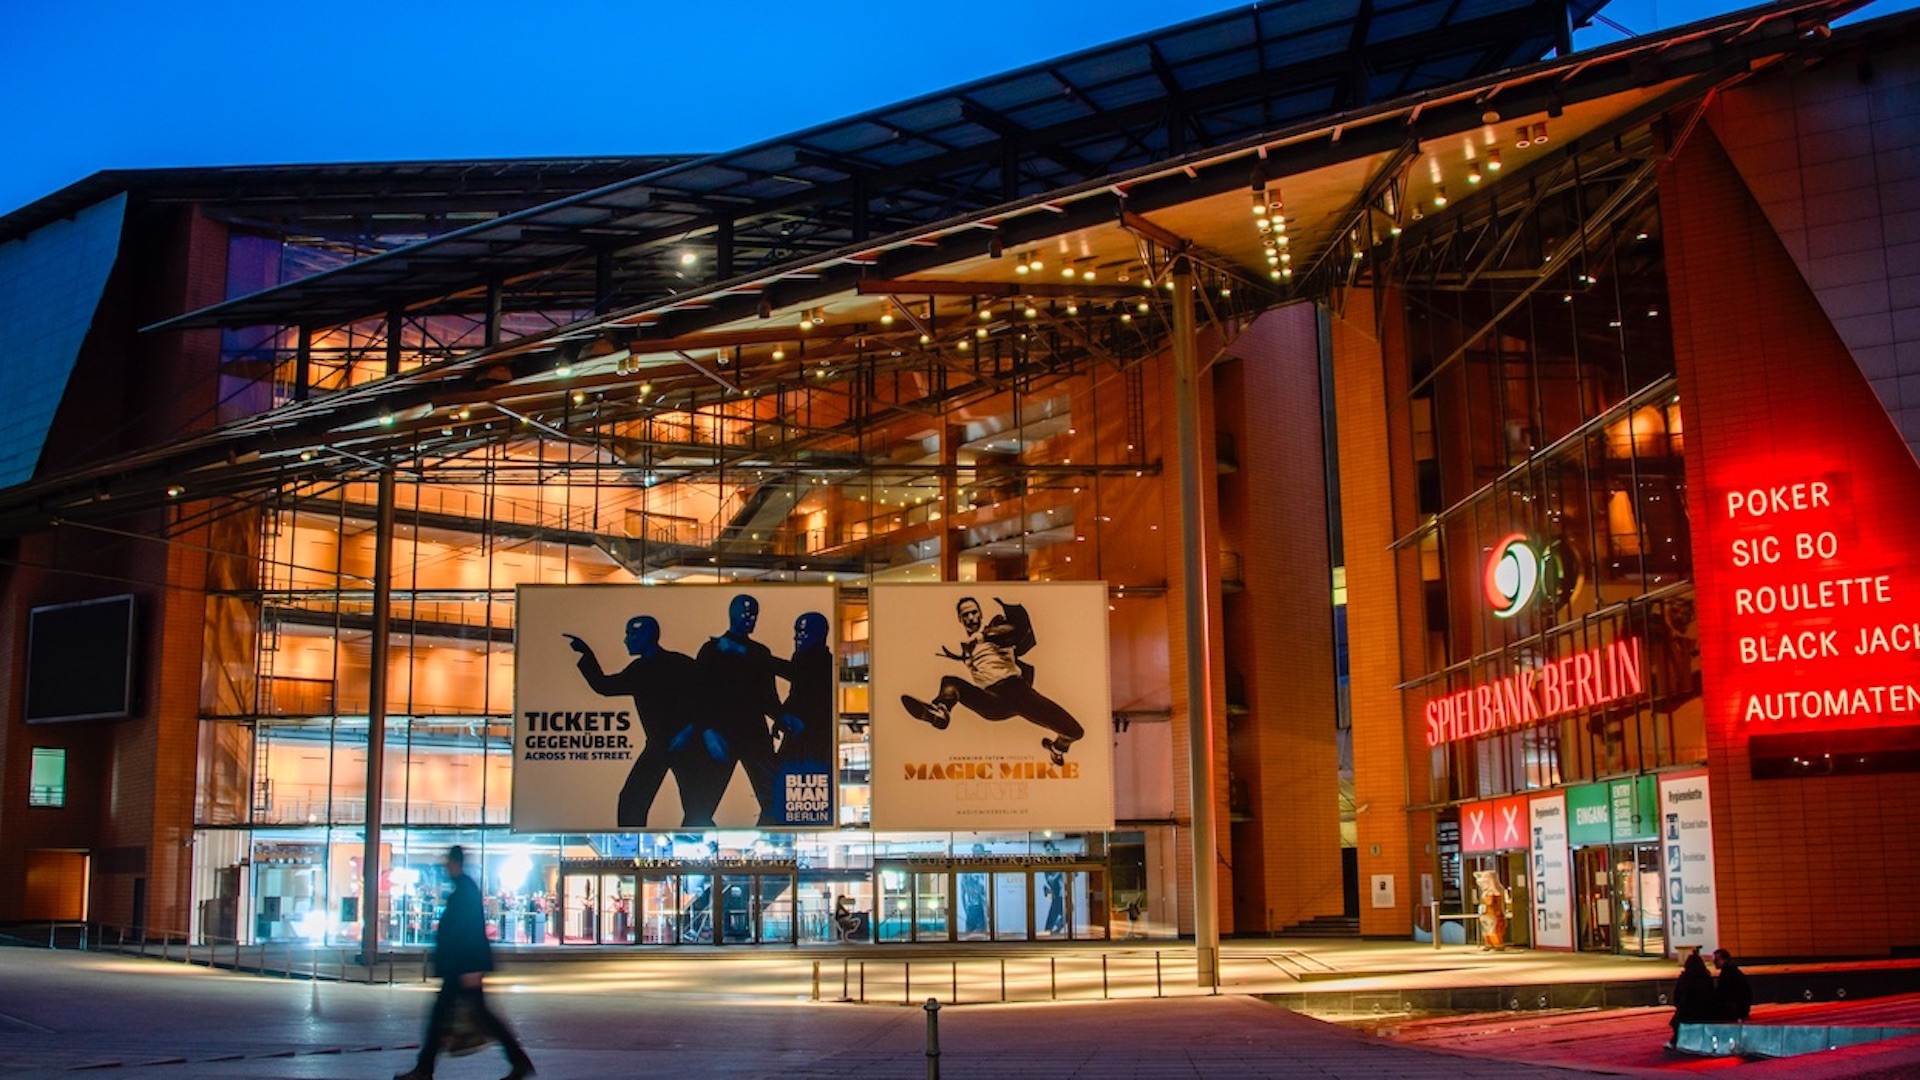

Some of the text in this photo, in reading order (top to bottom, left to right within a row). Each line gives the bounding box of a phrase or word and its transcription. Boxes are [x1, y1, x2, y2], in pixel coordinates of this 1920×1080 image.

[1727, 481, 1830, 518] POKER
[1731, 531, 1838, 567] SIC BO
[1735, 575, 1892, 615] ROULETTE
[1739, 630, 1839, 664] BLACK
[1426, 636, 1642, 747] SPIELBANK BERLIN
[524, 711, 631, 731] TICKETS
[525, 732, 633, 749] GEGENÜBER.
[524, 751, 632, 761] ACROSS THE STREET.
[904, 762, 1079, 780] MAGIC MIKE
[785, 774, 829, 788] BLUE
[785, 787, 829, 802] MAN
[955, 782, 1029, 801] LIVE
[785, 801, 829, 812] GROUP
[1576, 804, 1608, 825] EINGANG
[785, 811, 829, 822] BERLIN
[1020, 854, 1076, 865] BERLIN
